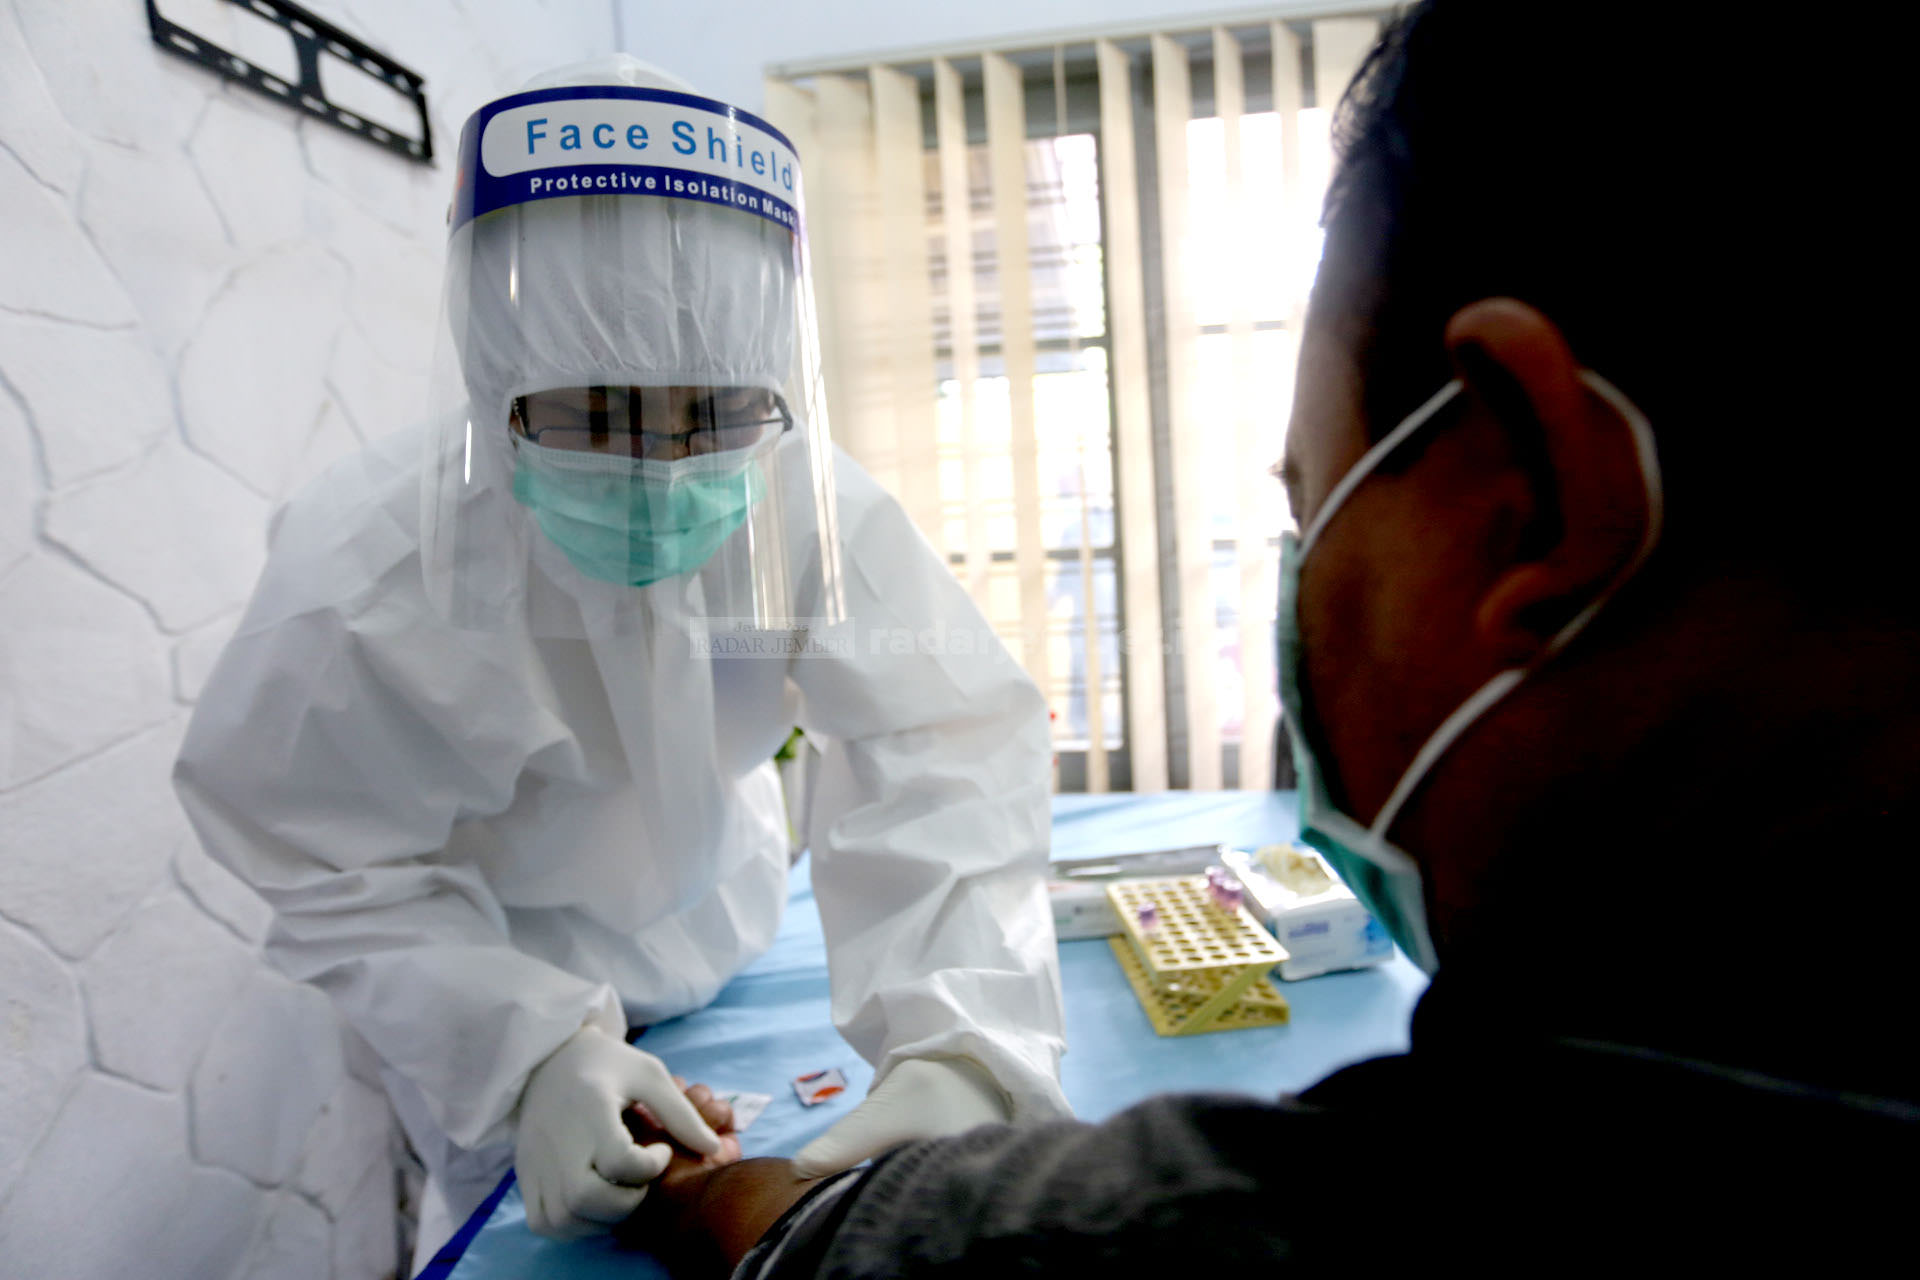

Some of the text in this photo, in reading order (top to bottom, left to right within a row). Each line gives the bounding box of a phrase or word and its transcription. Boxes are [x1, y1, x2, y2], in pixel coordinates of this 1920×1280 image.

[526, 118, 794, 192] Face Shield
[530, 173, 795, 225] Protective Isolation Mask
